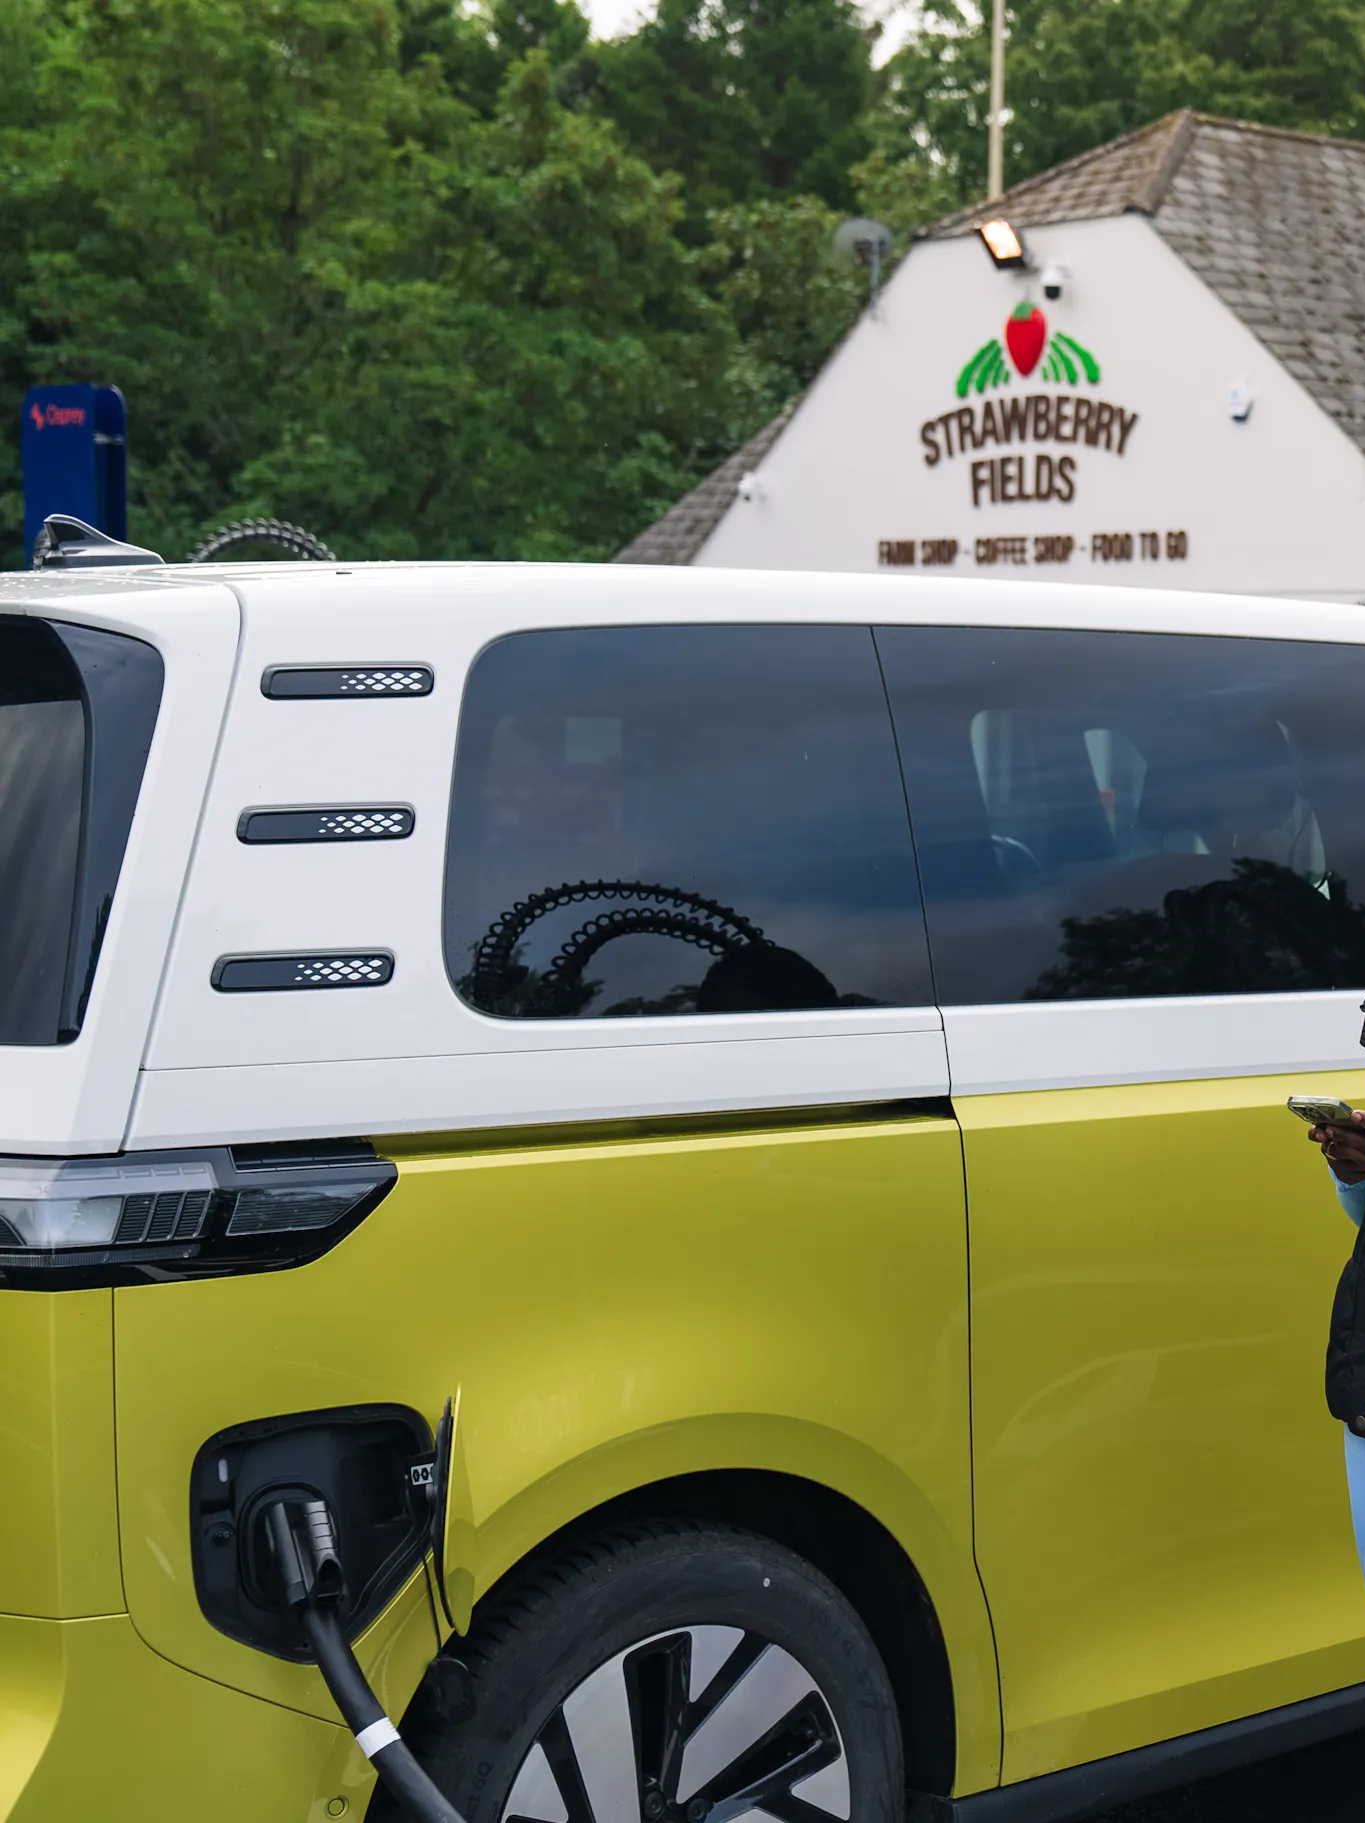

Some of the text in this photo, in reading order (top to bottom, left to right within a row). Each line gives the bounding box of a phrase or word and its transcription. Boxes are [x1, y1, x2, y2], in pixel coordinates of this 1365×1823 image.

[919, 395, 1139, 467] STRAWBERRY
[971, 455, 1077, 507] FIELDS
[878, 530, 1188, 566] FARM SHOP COFFEE SHOP FOOD TO GO
